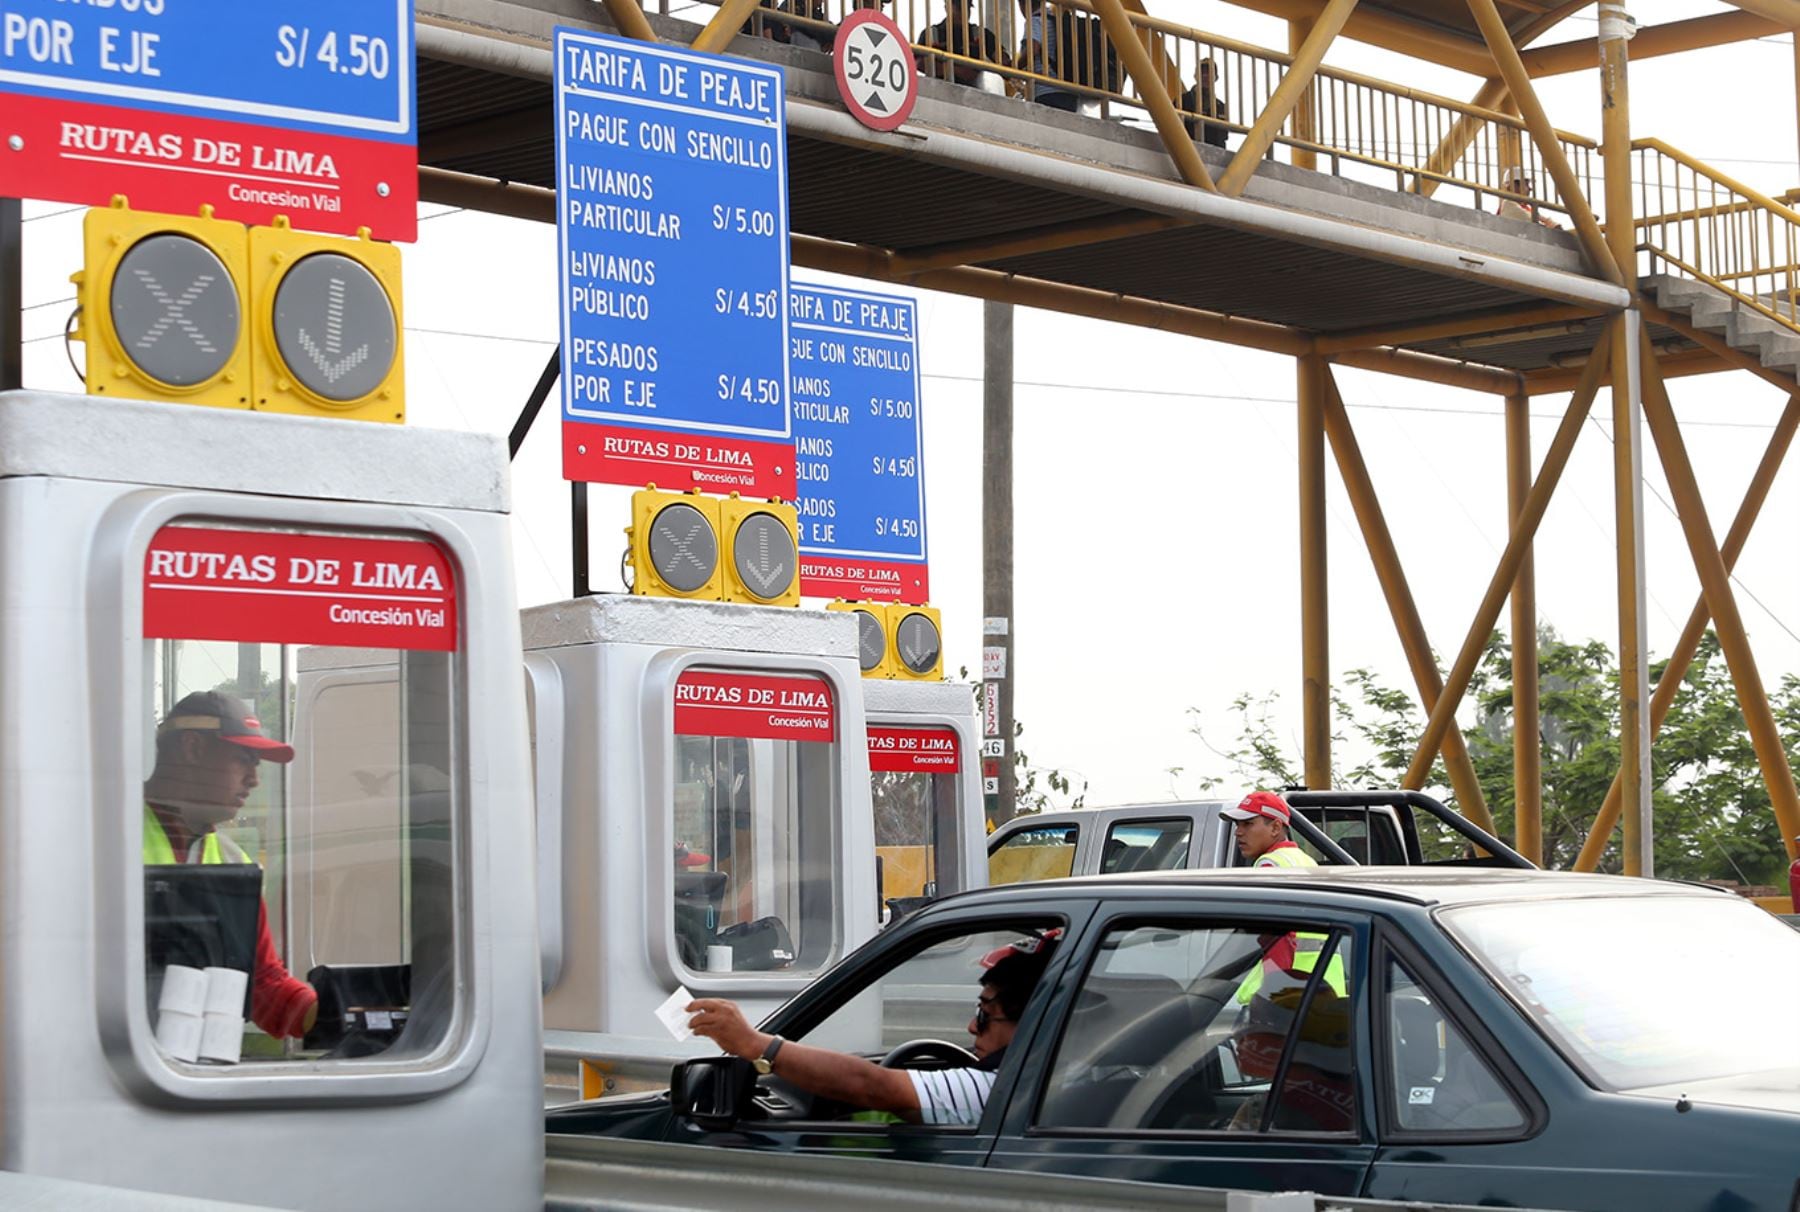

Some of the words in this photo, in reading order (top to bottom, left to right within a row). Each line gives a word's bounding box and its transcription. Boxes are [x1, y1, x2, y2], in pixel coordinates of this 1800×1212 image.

[4, 12, 74, 65] POR
[100, 26, 161, 77] EJE
[567, 46, 646, 91] TARIFA
[659, 63, 688, 99] DE
[701, 70, 771, 113] PEAJE
[847, 46, 905, 92] 5.20
[59, 121, 183, 160] RUTAS
[192, 138, 242, 167] DE
[252, 146, 340, 180] LIMA
[568, 110, 629, 147] PAGUE
[639, 122, 677, 154] CON
[687, 131, 772, 170] SENCILLO
[569, 164, 653, 200] LIVIANOS
[311, 194, 341, 213] Vial
[570, 200, 681, 240] PARTICULAR
[571, 250, 656, 286] LIVIANOS
[572, 284, 649, 321] PÚBLICO
[790, 293, 825, 321] RIFA
[833, 299, 853, 325] DE
[860, 303, 909, 332] PEAJE
[573, 337, 658, 372] PESADOS
[792, 338, 814, 360] GUE
[820, 341, 846, 364] CON
[852, 345, 910, 372] SENCILLO
[574, 374, 611, 404] POR
[624, 380, 657, 408] EJE
[793, 376, 831, 398] IANOS
[793, 401, 849, 424] RTICULAR
[604, 437, 669, 458] RUTAS
[674, 444, 700, 460] DE
[706, 447, 754, 466] LIMA
[795, 436, 833, 457] IANOS
[738, 475, 755, 487] Vial
[796, 461, 829, 482] BLICO
[796, 497, 836, 518] SADOS
[813, 523, 836, 543] EJE
[149, 550, 276, 583] RUTAS
[288, 558, 340, 585] DE
[352, 562, 443, 591] LIMA
[801, 564, 844, 578] RUTAS
[847, 567, 865, 580] DE
[869, 569, 901, 582] LIMA
[329, 603, 413, 626] Concesión
[415, 609, 444, 628] Vial
[676, 684, 741, 703] RUTAS
[747, 688, 774, 704] DE
[780, 691, 828, 708] LIMA
[768, 715, 812, 728] Concesión
[813, 718, 829, 729] Vial
[867, 736, 895, 748] TAS
[898, 737, 917, 749] DE
[921, 738, 953, 750] LIMA
